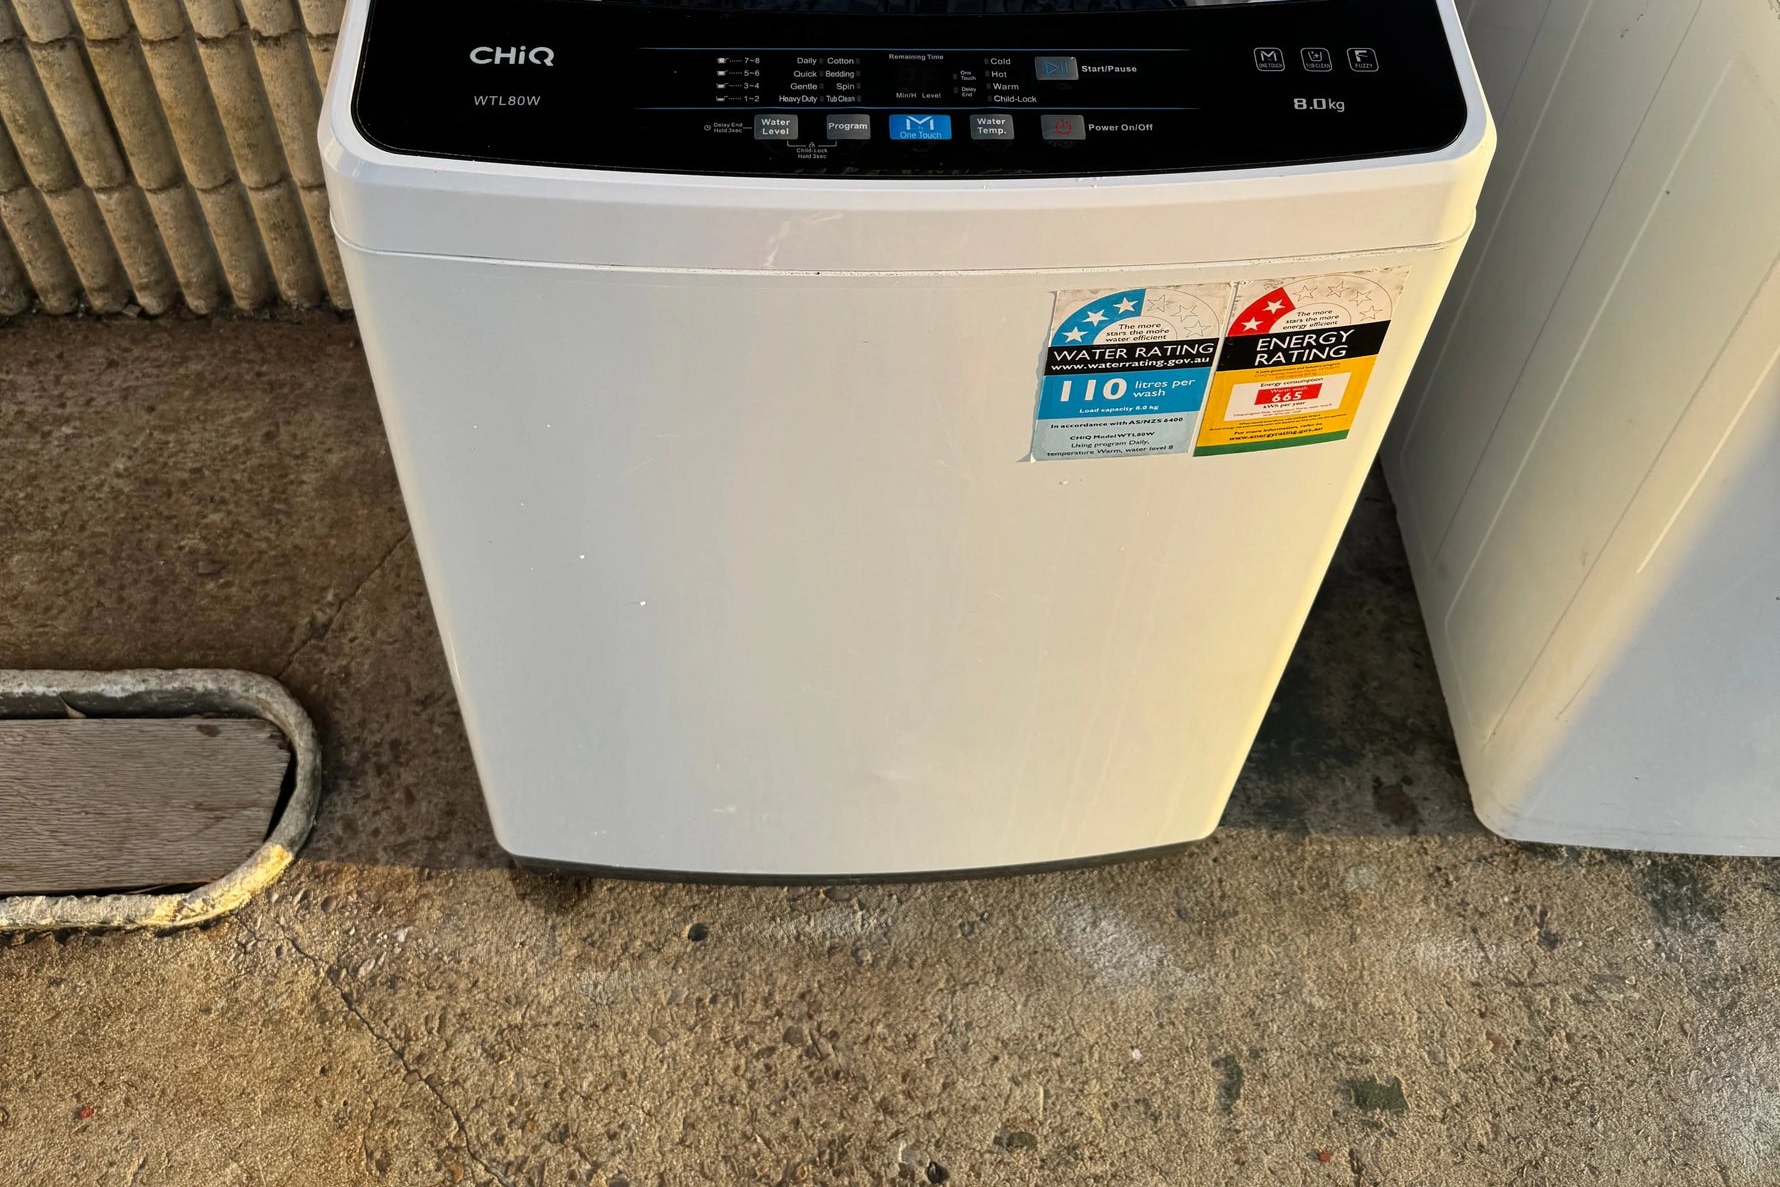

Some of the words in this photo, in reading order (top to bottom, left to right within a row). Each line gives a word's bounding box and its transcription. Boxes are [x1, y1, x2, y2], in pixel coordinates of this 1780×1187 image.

[469, 45, 555, 67] CHiQ
[889, 53, 926, 61] Remaining
[797, 57, 817, 66] Daily
[827, 57, 854, 65] Cotton
[990, 57, 1011, 65] Cold
[1081, 65, 1138, 73] Start/Pause
[793, 70, 817, 78] Quick
[825, 70, 855, 79] Bedding
[836, 82, 855, 91] Spin
[993, 83, 1019, 91] Warm
[473, 95, 542, 106] WTL80W
[779, 95, 801, 103] Heavy
[802, 95, 818, 104] Duty
[994, 95, 1038, 103] Child-Lock
[761, 118, 791, 127] Water
[977, 117, 1006, 125] Water
[762, 127, 789, 135] Level
[828, 122, 868, 132] Program
[977, 127, 1007, 136] Temp.
[1121, 123, 1154, 131] On/Off
[900, 131, 918, 139] One
[919, 131, 942, 139] Touch
[1282, 323, 1308, 331] energy
[1309, 320, 1338, 329] efficient
[1132, 334, 1167, 342] efficient
[1256, 329, 1355, 352] ENERGY
[1053, 347, 1127, 362] WATER
[1134, 342, 1215, 358] RATING
[1254, 345, 1349, 366] RATING
[1051, 356, 1210, 372] www.waterrating.gov.au
[1135, 380, 1168, 389] litres
[1171, 379, 1196, 388] per
[1260, 380, 1282, 389] Energy
[1283, 377, 1324, 386] consumption
[1059, 378, 1128, 402] 110
[1133, 389, 1166, 398] wash
[1270, 386, 1291, 394] Warm
[1271, 392, 1303, 403] 665
[1071, 442, 1092, 450] Using
[1094, 440, 1126, 449] program
[1047, 450, 1095, 458] temperature
